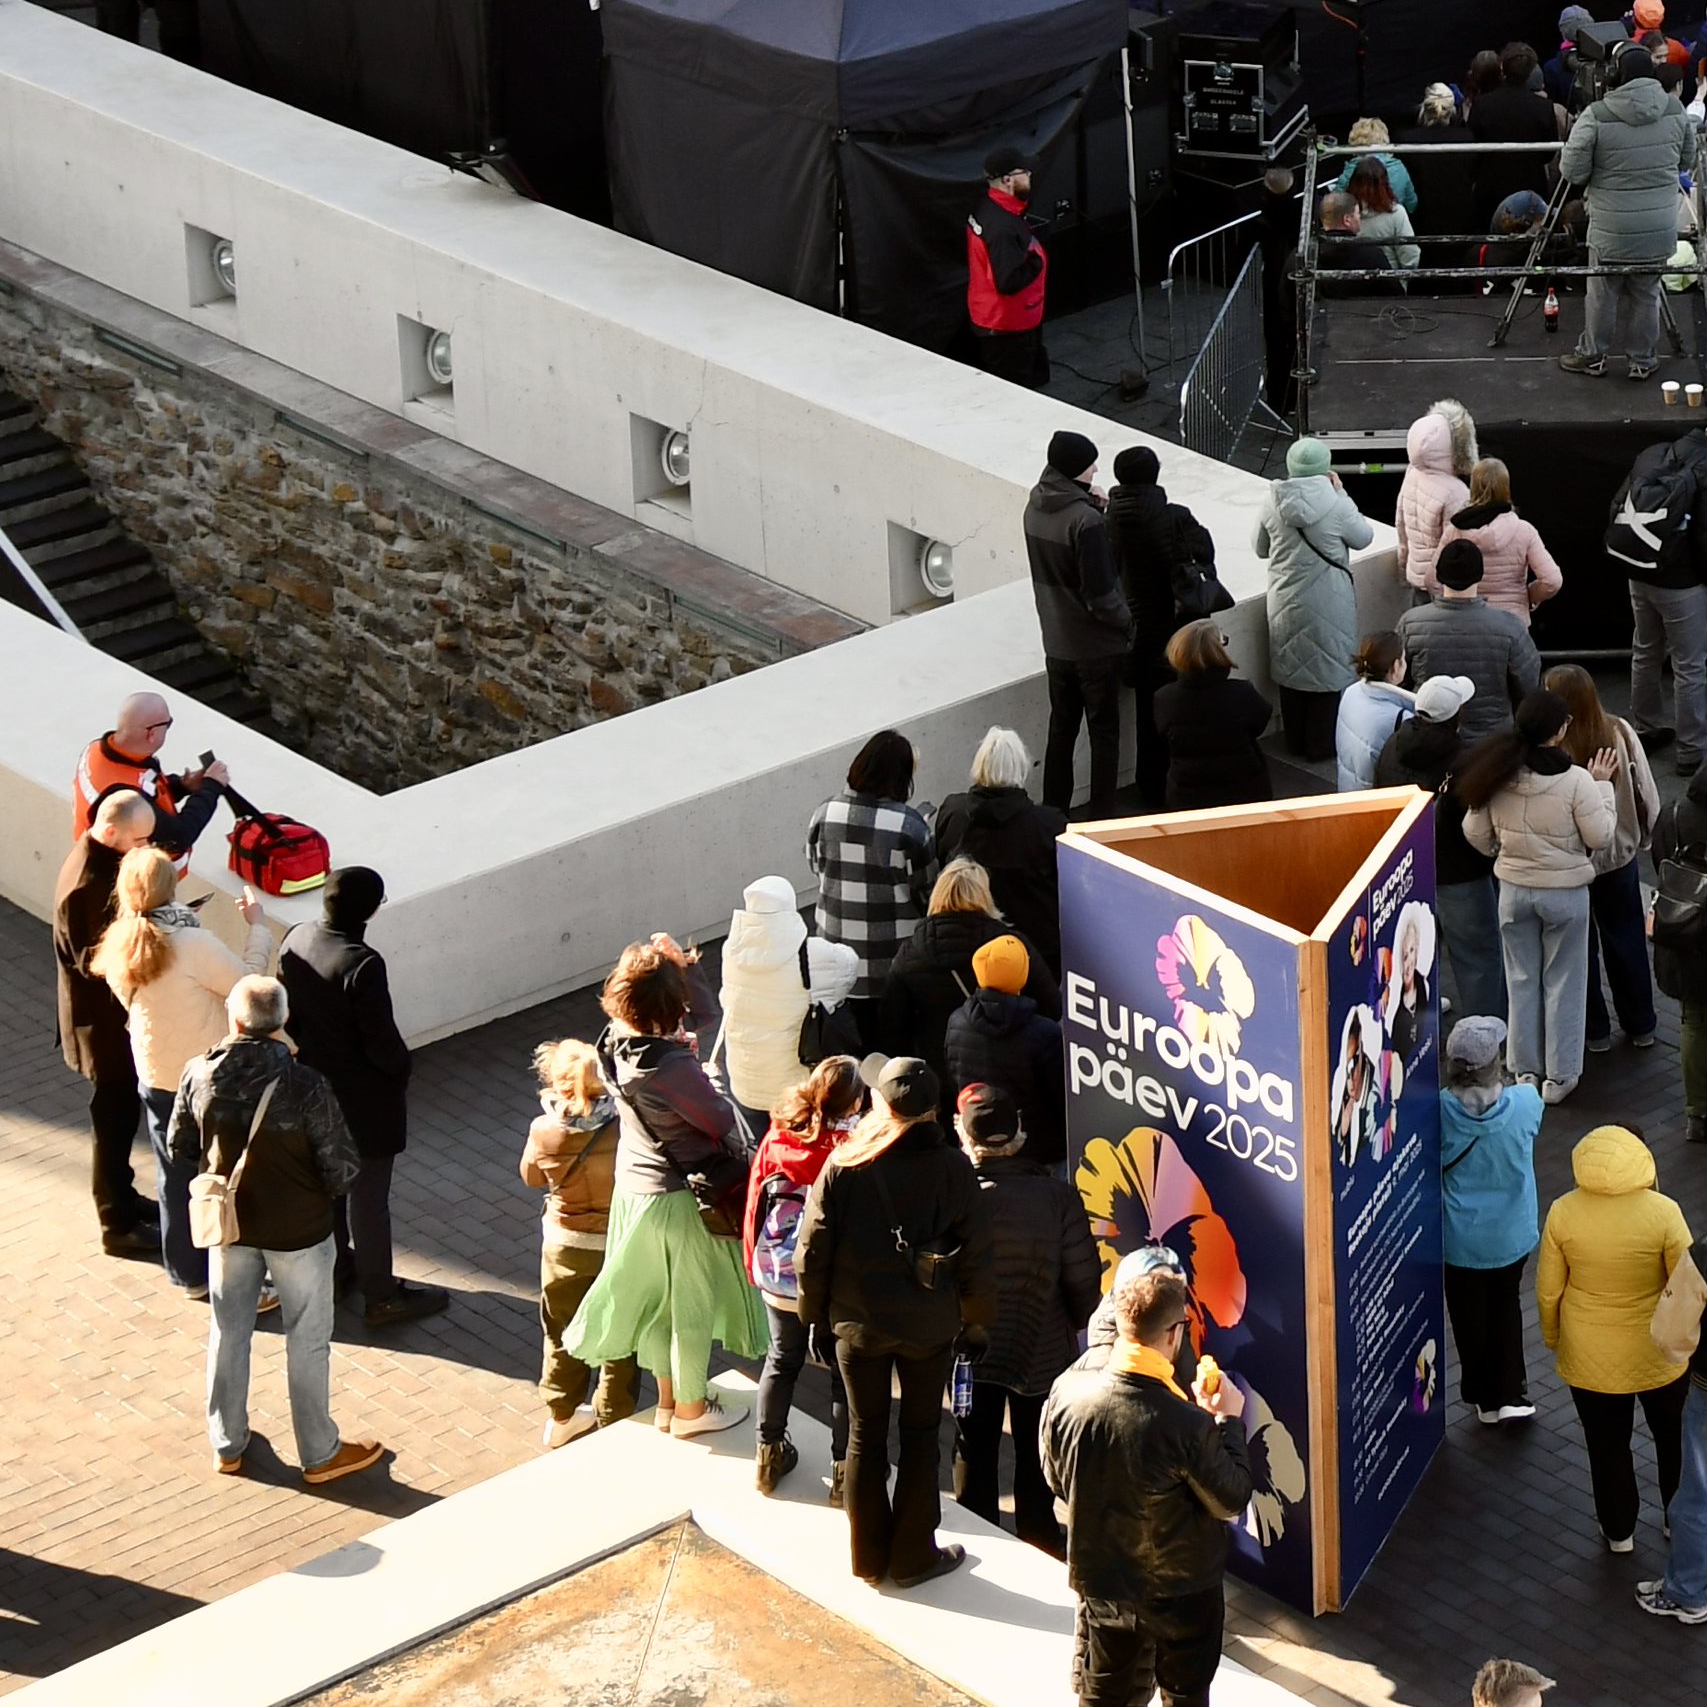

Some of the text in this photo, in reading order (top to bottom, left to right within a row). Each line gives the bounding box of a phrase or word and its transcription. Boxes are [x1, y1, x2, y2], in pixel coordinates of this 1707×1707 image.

[1372, 848, 1414, 914] Euroopa
[1372, 869, 1414, 942] päev 2025
[1066, 971, 1294, 1123] Euroopa
[1069, 1042, 1298, 1182] päev 2025
